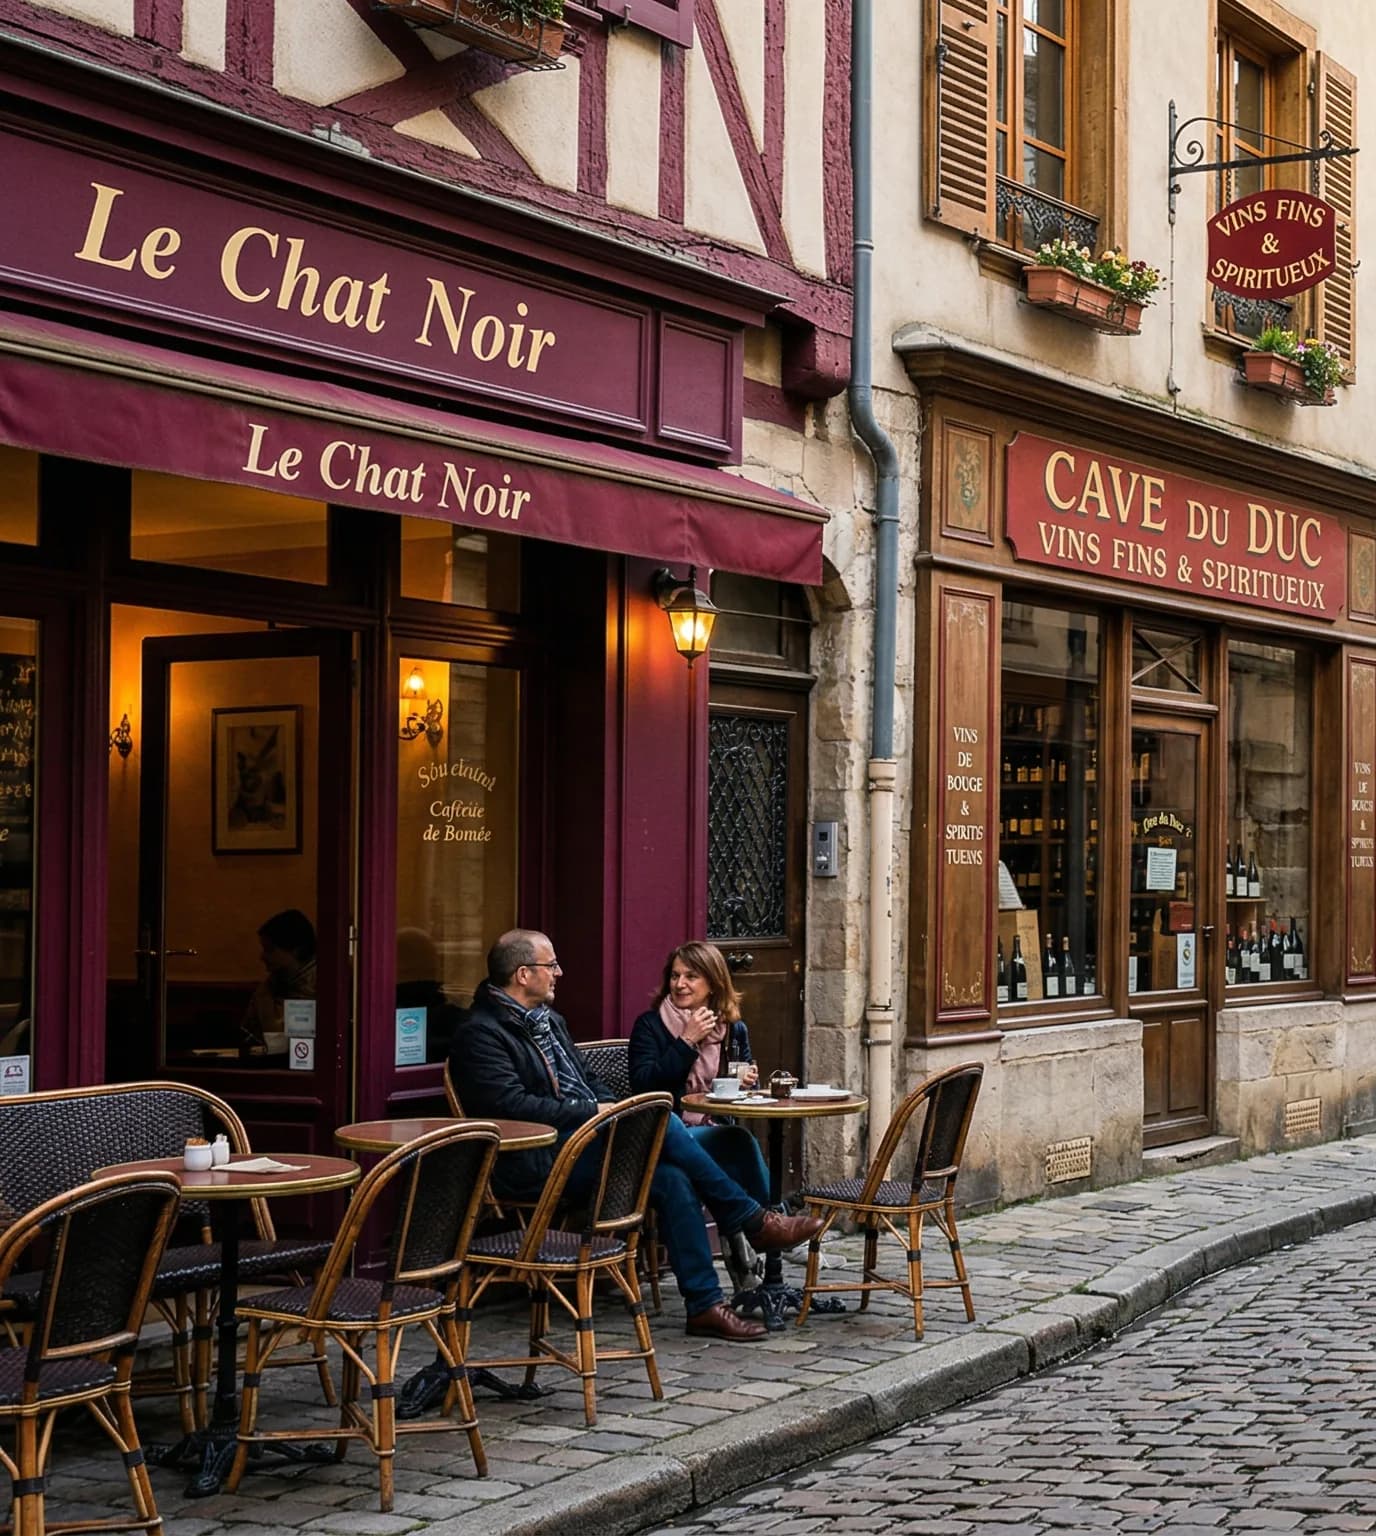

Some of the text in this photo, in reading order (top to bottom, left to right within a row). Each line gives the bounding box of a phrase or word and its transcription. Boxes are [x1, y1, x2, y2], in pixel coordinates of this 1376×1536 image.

[1215, 198, 1328, 238] VINS FINS
[1261, 233, 1280, 255] &
[74, 182, 556, 373] Le Chat Noir
[1211, 247, 1332, 290] SPIRITUEUX
[242, 423, 533, 521] Le Chat Noir
[1044, 450, 1323, 568] CAVE DU DUC
[1038, 520, 1327, 610] VINS FINS & SPIRITUEUX
[953, 726, 978, 743] VINS
[958, 751, 973, 768] DE
[947, 774, 983, 792] BOUGE
[960, 800, 970, 816] &
[423, 823, 440, 841] de
